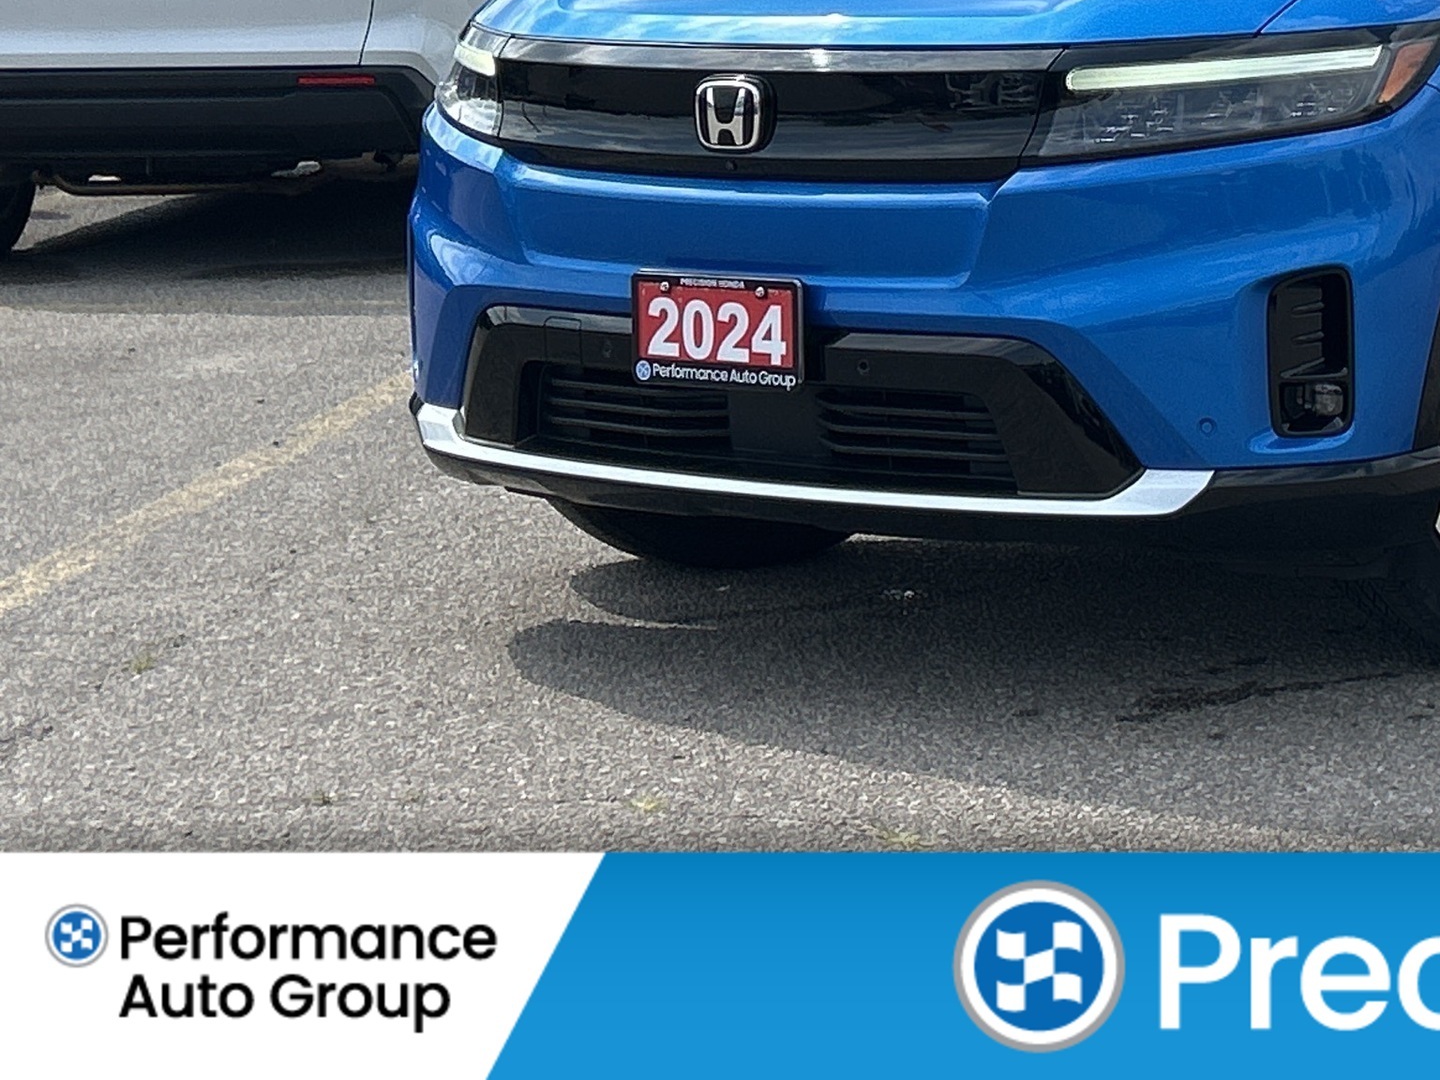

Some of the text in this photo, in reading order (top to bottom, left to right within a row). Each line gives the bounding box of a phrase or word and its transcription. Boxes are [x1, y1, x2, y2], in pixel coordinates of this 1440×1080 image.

[647, 296, 787, 366] 2024
[652, 362, 796, 392] Performance Auto Group
